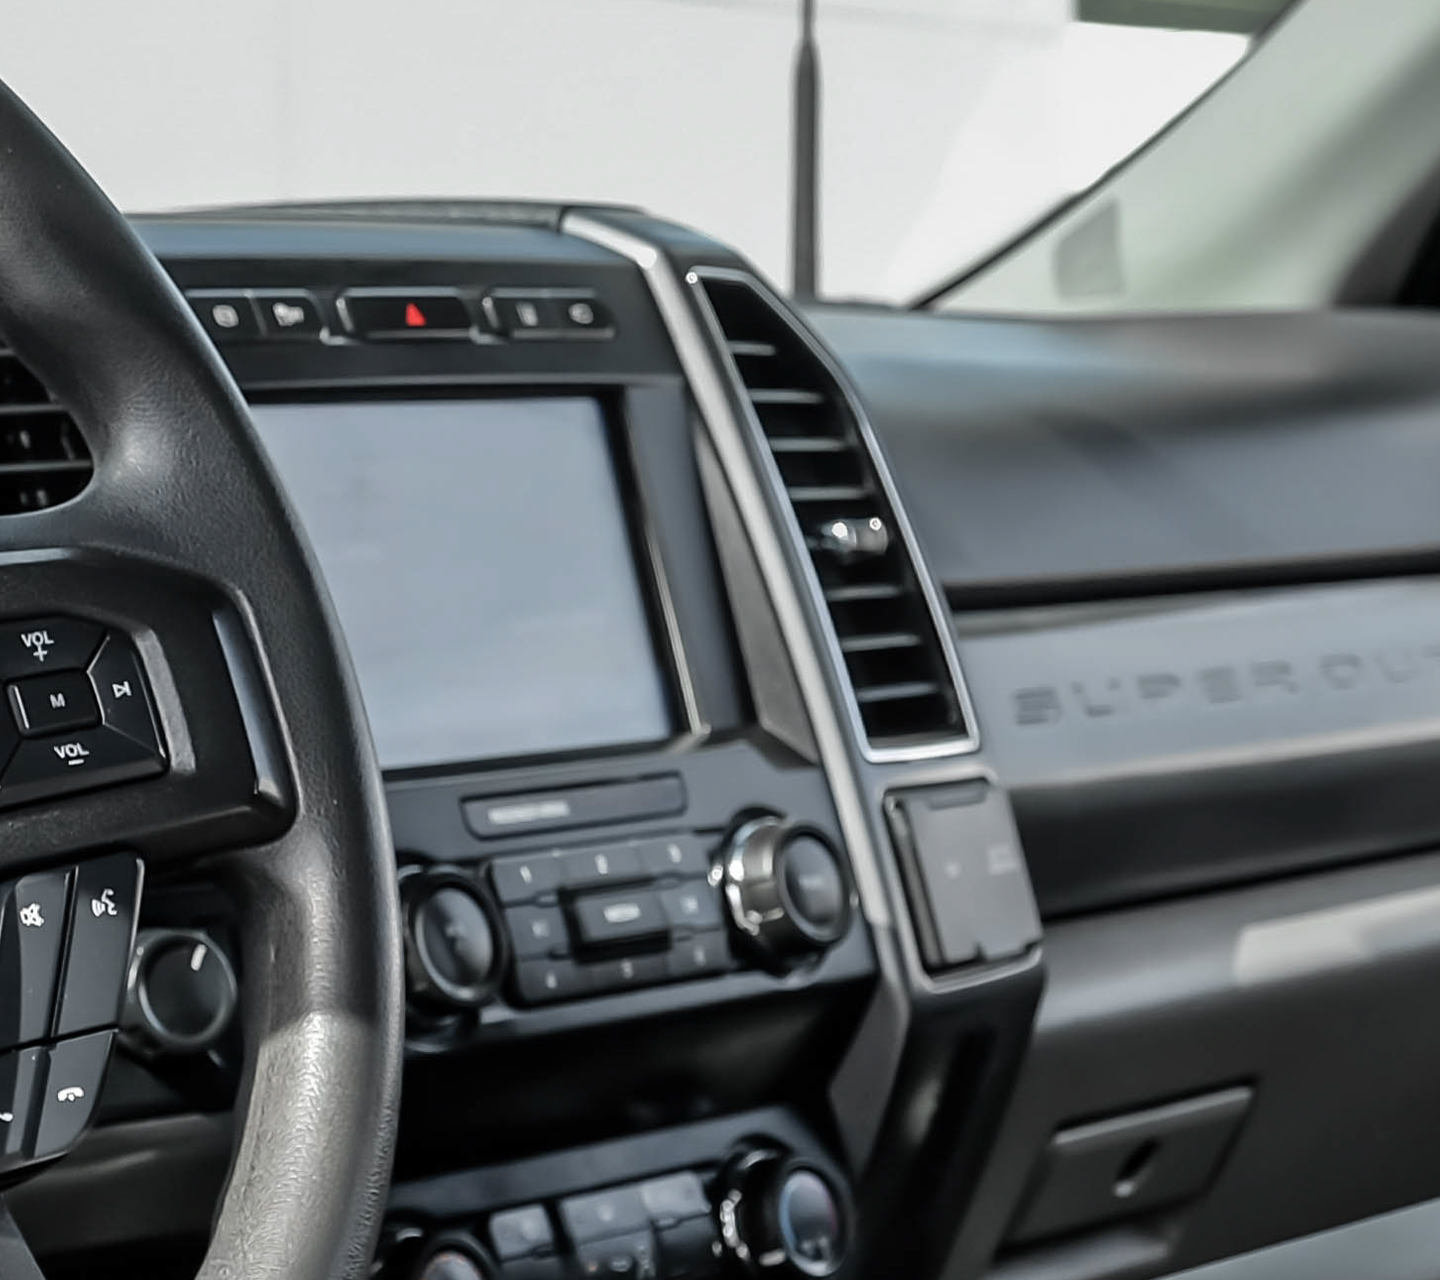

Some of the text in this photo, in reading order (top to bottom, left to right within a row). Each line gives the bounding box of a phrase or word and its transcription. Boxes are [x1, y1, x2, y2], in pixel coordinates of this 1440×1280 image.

[21, 630, 54, 647] VOL
[1013, 658, 1304, 725] SUPER
[49, 692, 66, 709] M
[53, 742, 90, 759] VOL
